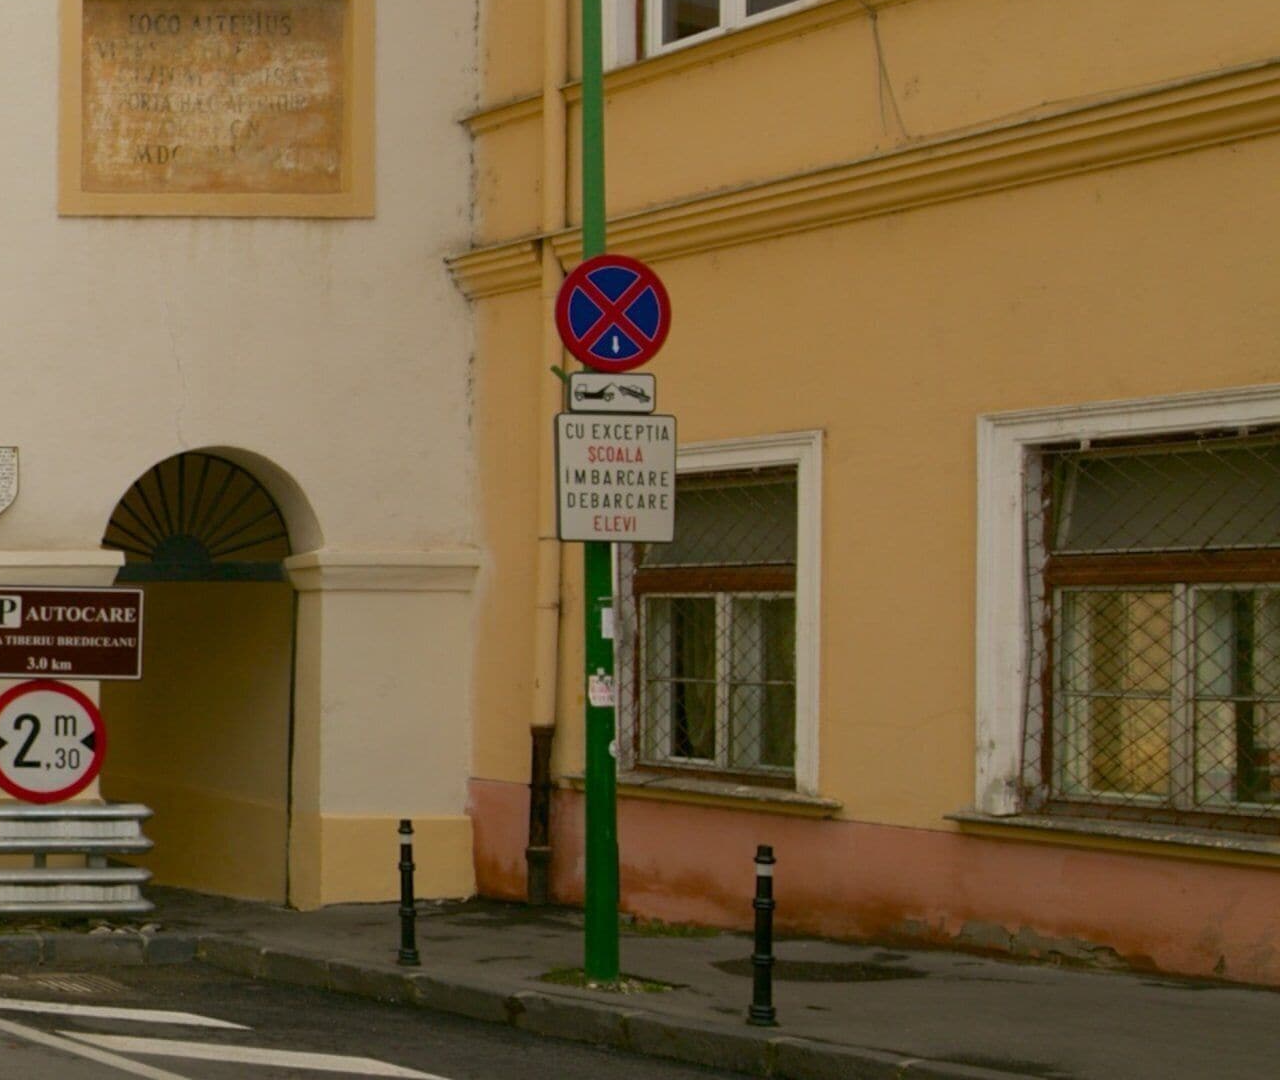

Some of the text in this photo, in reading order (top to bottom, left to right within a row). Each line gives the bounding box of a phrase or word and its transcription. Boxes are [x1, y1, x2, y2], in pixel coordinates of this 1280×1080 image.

[565, 423, 585, 439] CU
[567, 492, 669, 510] DEBARCARE
[593, 514, 637, 532] ELEVI
[25, 606, 137, 623] AUTOCARE
[6, 634, 54, 647] TIBERIU
[57, 636, 137, 648] BREDICEANU
[27, 656, 72, 670] 3.0 km
